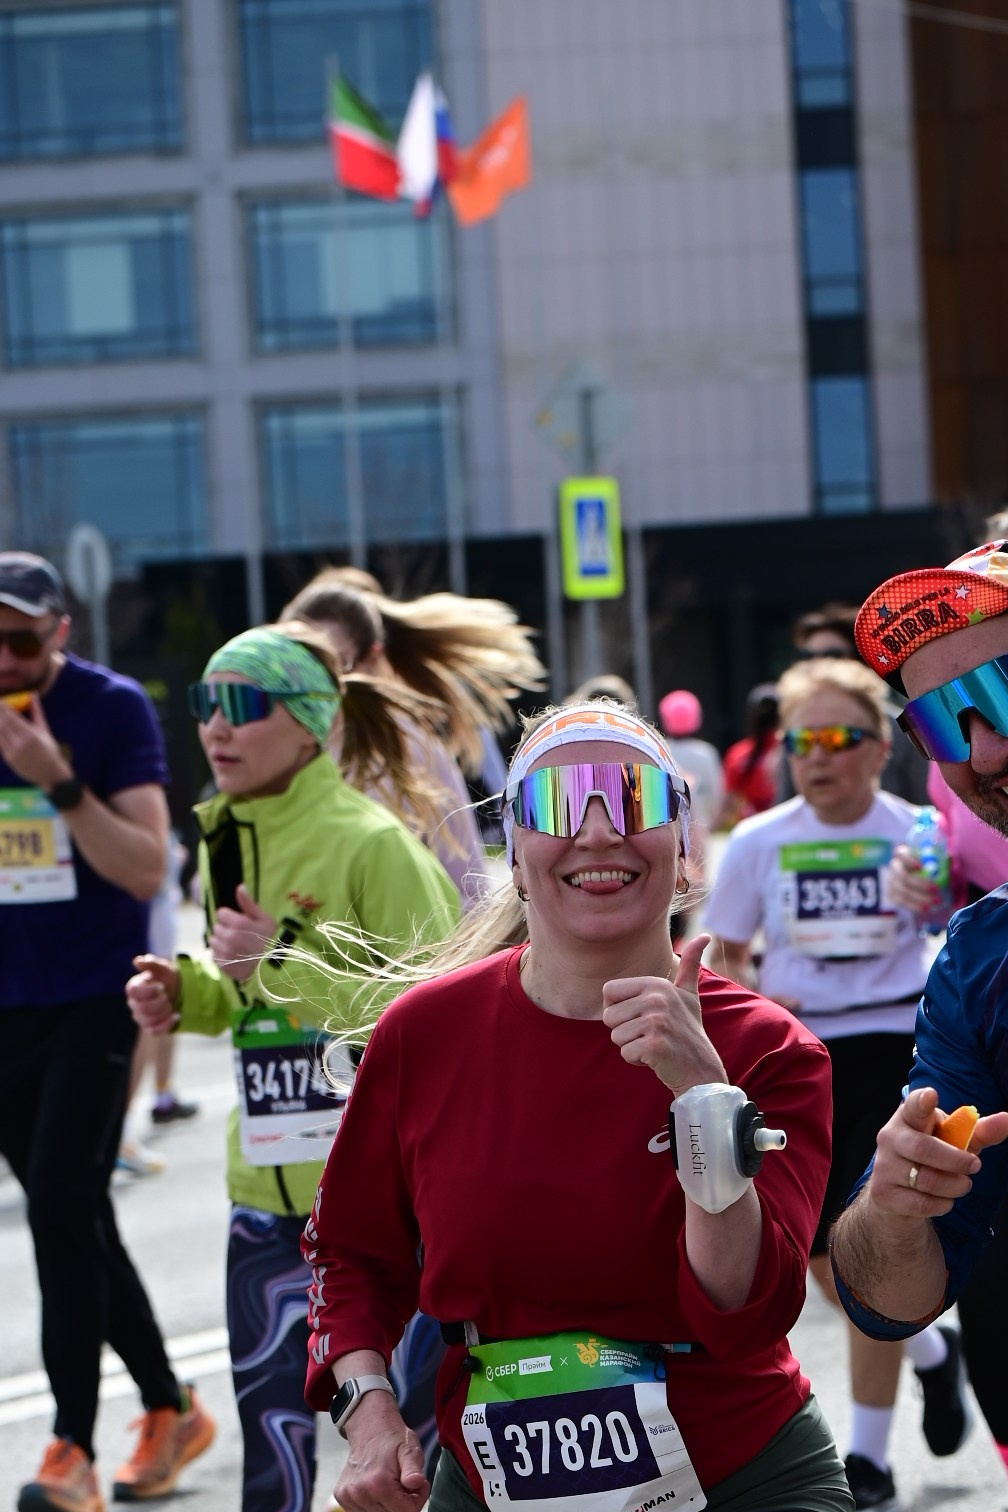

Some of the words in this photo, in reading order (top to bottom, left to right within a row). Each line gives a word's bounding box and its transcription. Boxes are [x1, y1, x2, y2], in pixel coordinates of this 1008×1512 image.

[881, 601, 960, 655] BIRRA
[689, 1124, 706, 1176] Luckfit
[494, 1363, 517, 1377] СБЕР
[522, 1361, 547, 1372] Прайм
[463, 1412, 485, 1426] 2026
[504, 1411, 639, 1477] 37820
